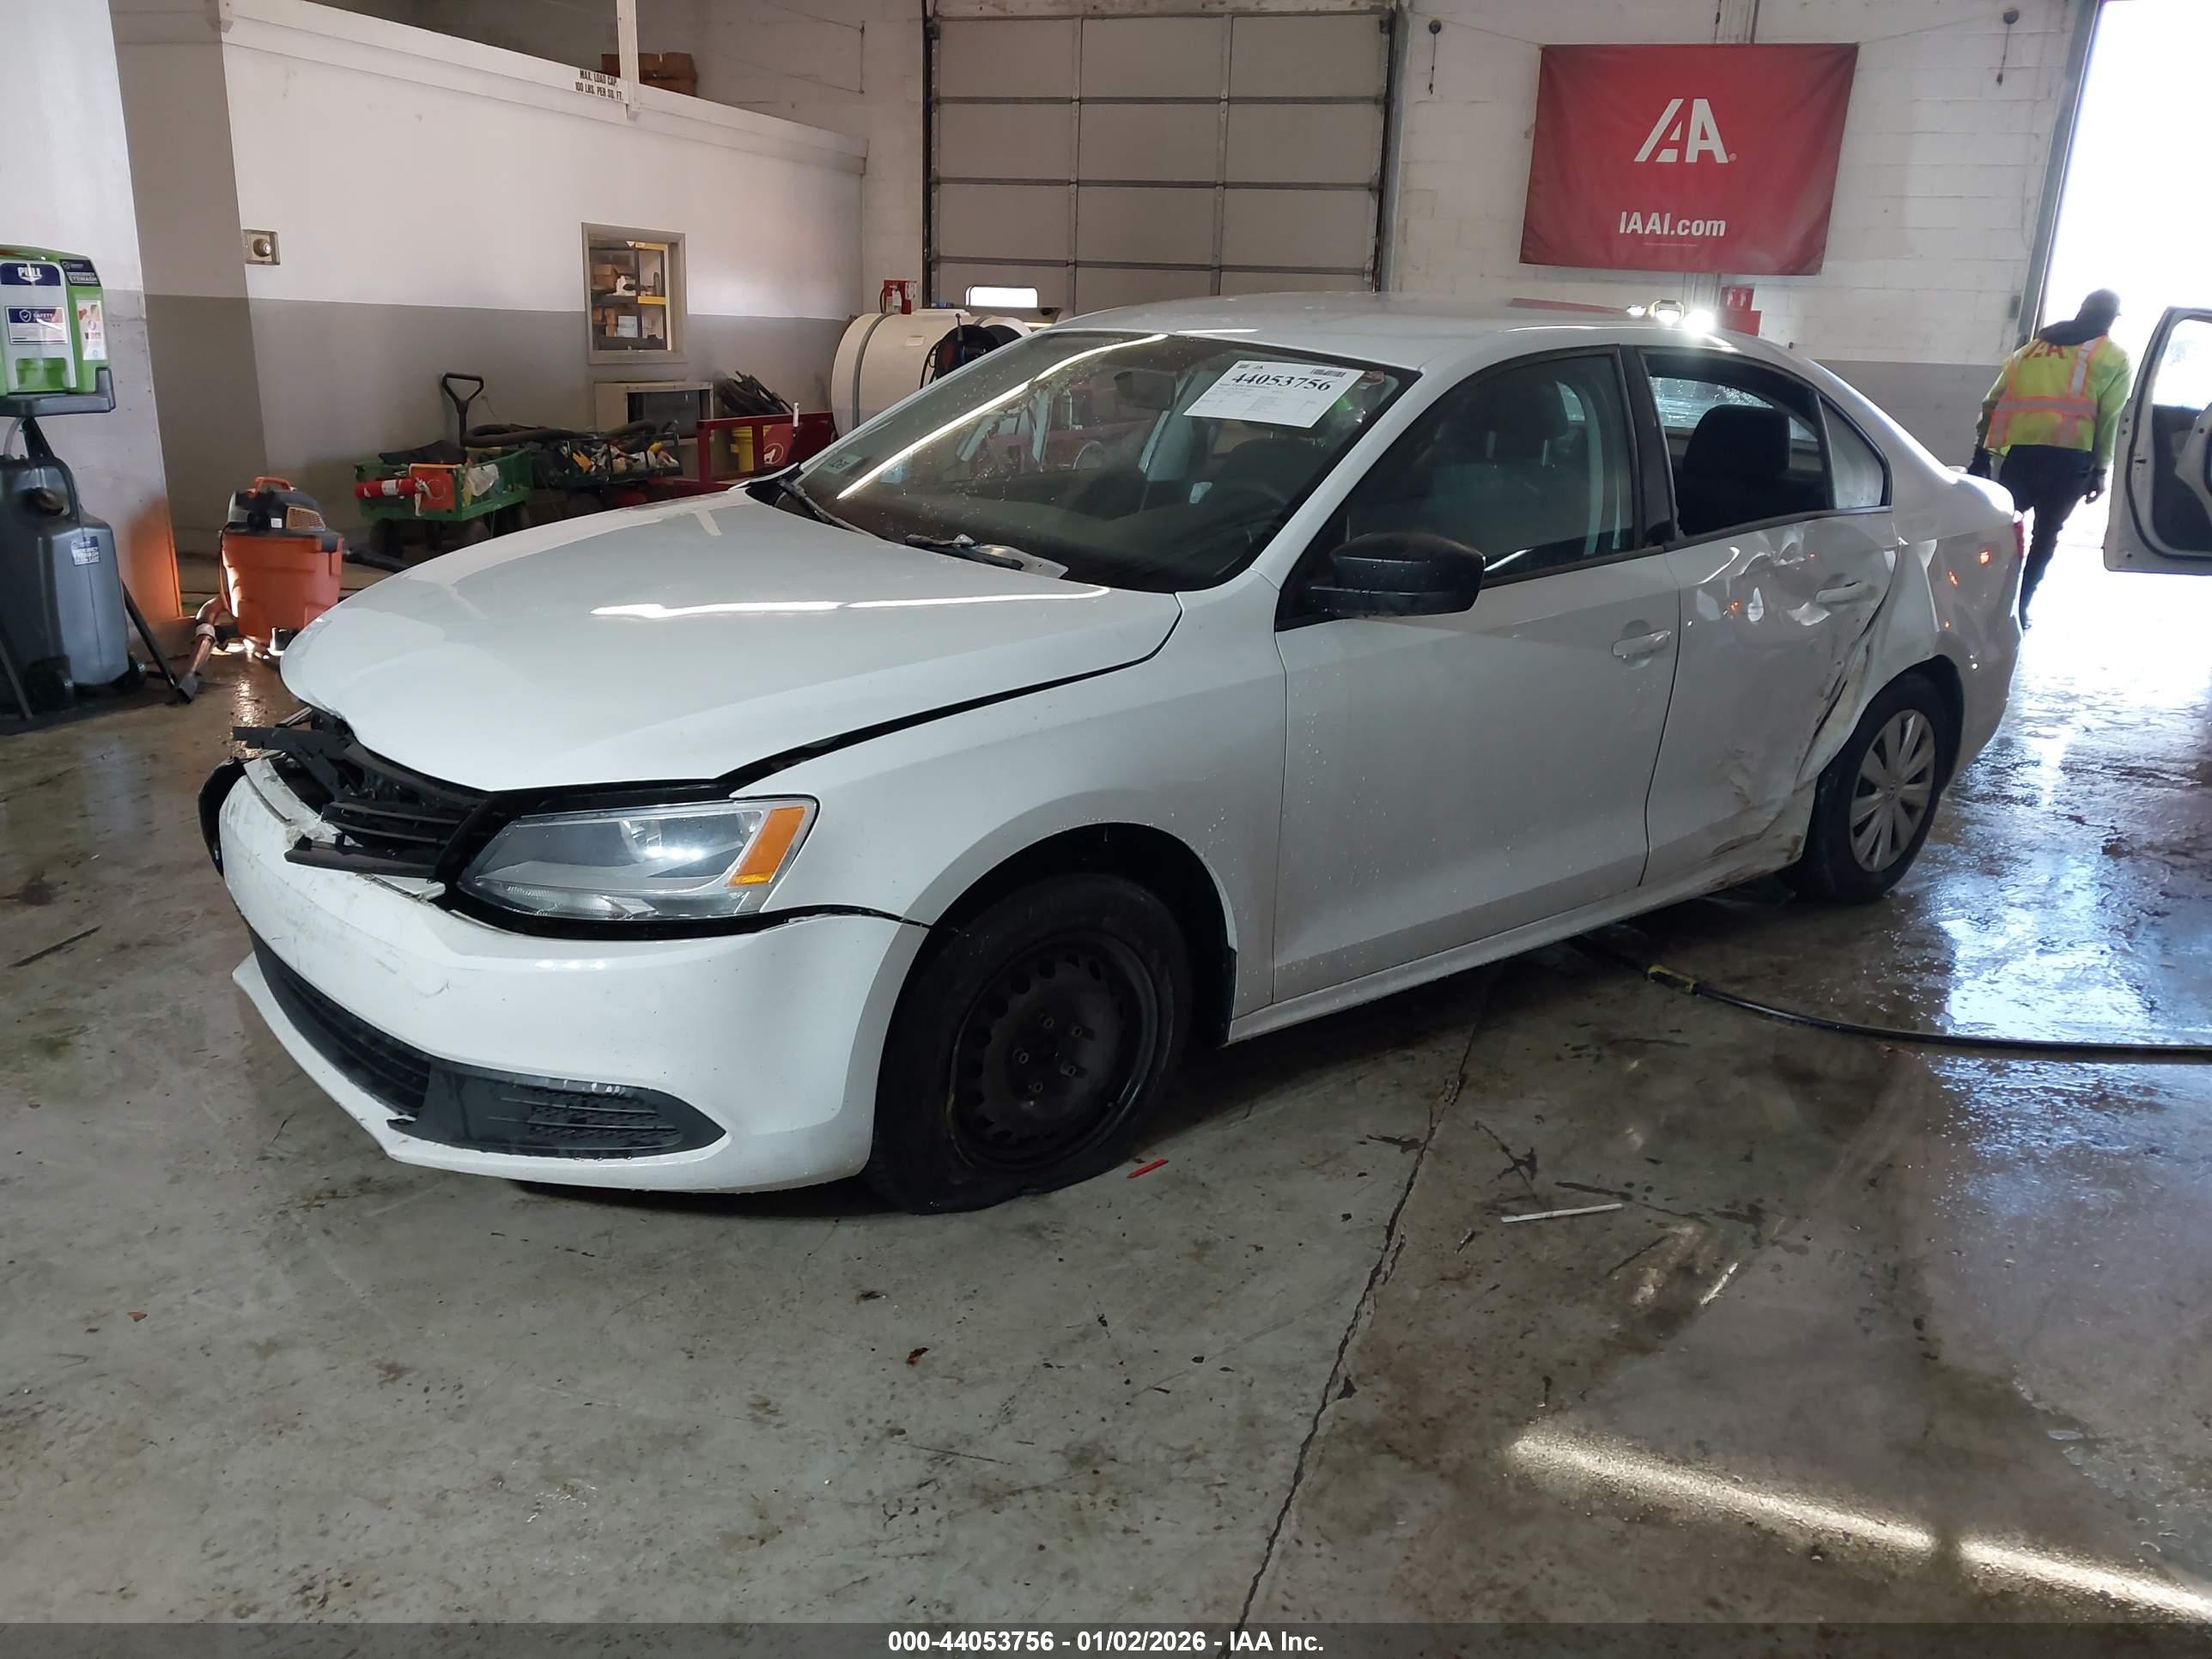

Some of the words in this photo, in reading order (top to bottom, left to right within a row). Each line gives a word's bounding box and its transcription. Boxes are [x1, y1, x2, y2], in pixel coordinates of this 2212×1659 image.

[594, 73, 606, 84] LOAD
[575, 82, 584, 92] 100
[597, 86, 606, 97] PER
[1620, 211, 1726, 236] IAAI.com
[1231, 373, 1334, 392] 44053756
